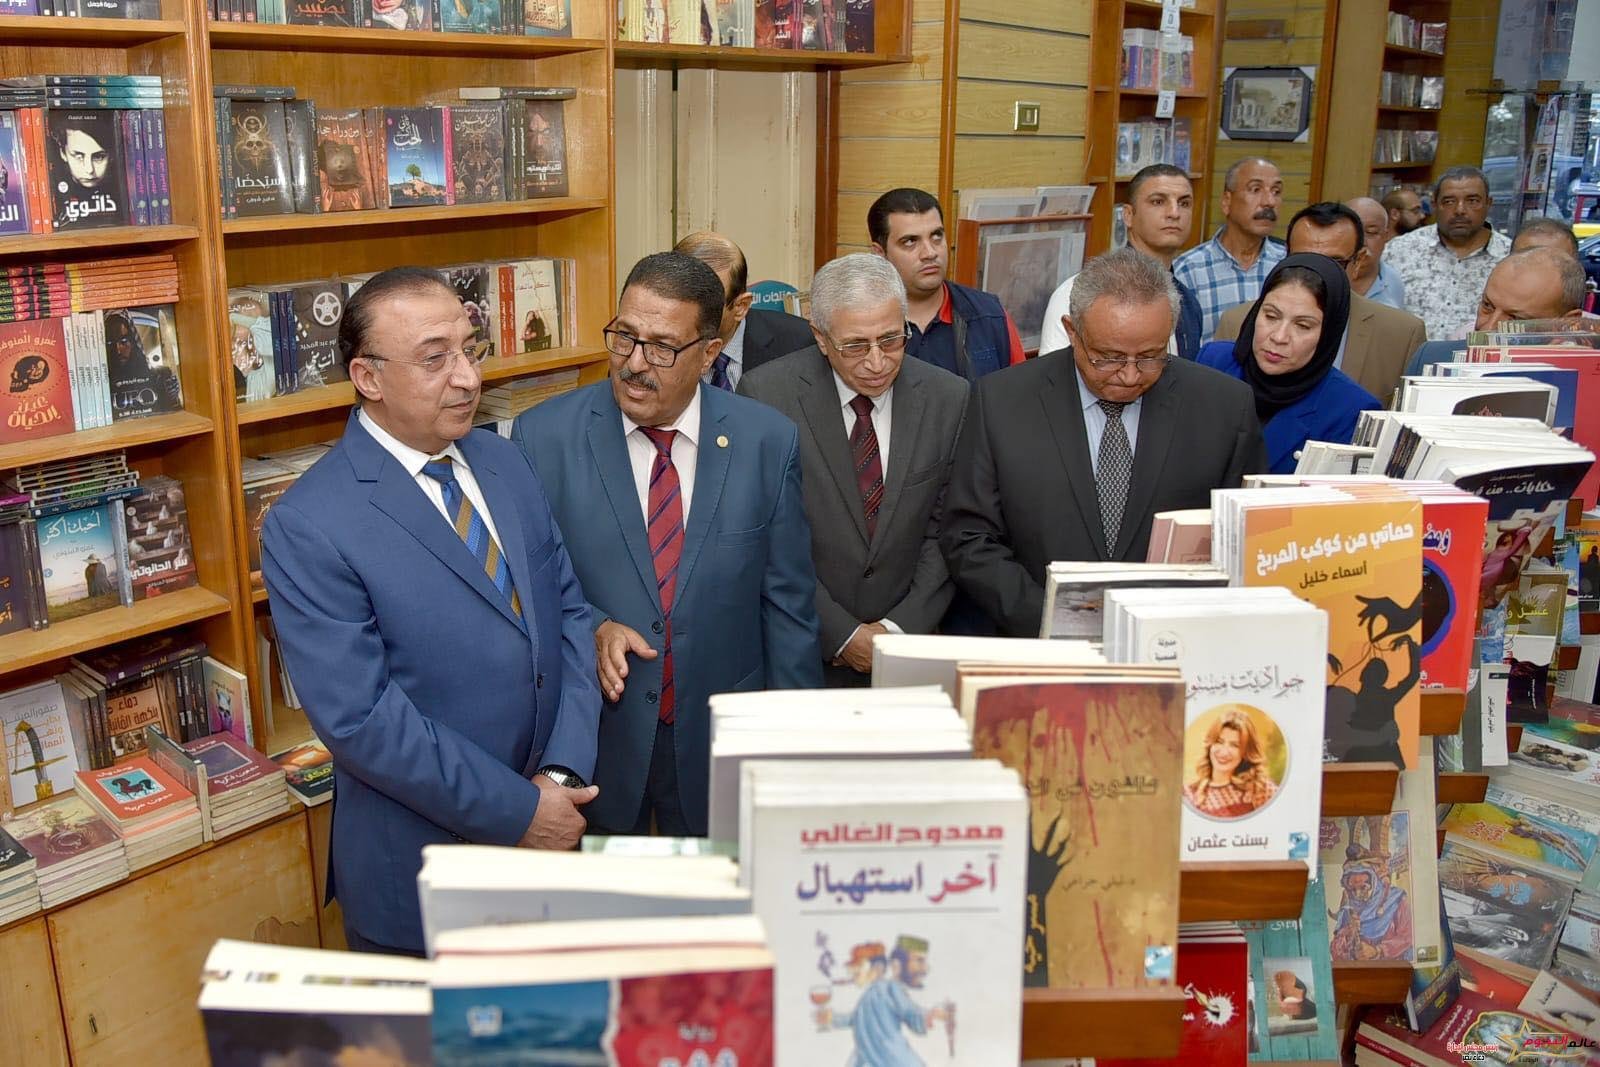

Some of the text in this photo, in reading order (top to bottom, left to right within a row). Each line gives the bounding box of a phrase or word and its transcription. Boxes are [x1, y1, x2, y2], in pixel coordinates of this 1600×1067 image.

[1256, 522, 1414, 576] حماتي من كوكب المريخ
[1299, 561, 1367, 589] أسماء خليل
[800, 822, 1004, 848] ممدوح الغالي
[1187, 832, 1268, 852] بسنت عثمان
[797, 852, 1000, 904] آخر استهبال
